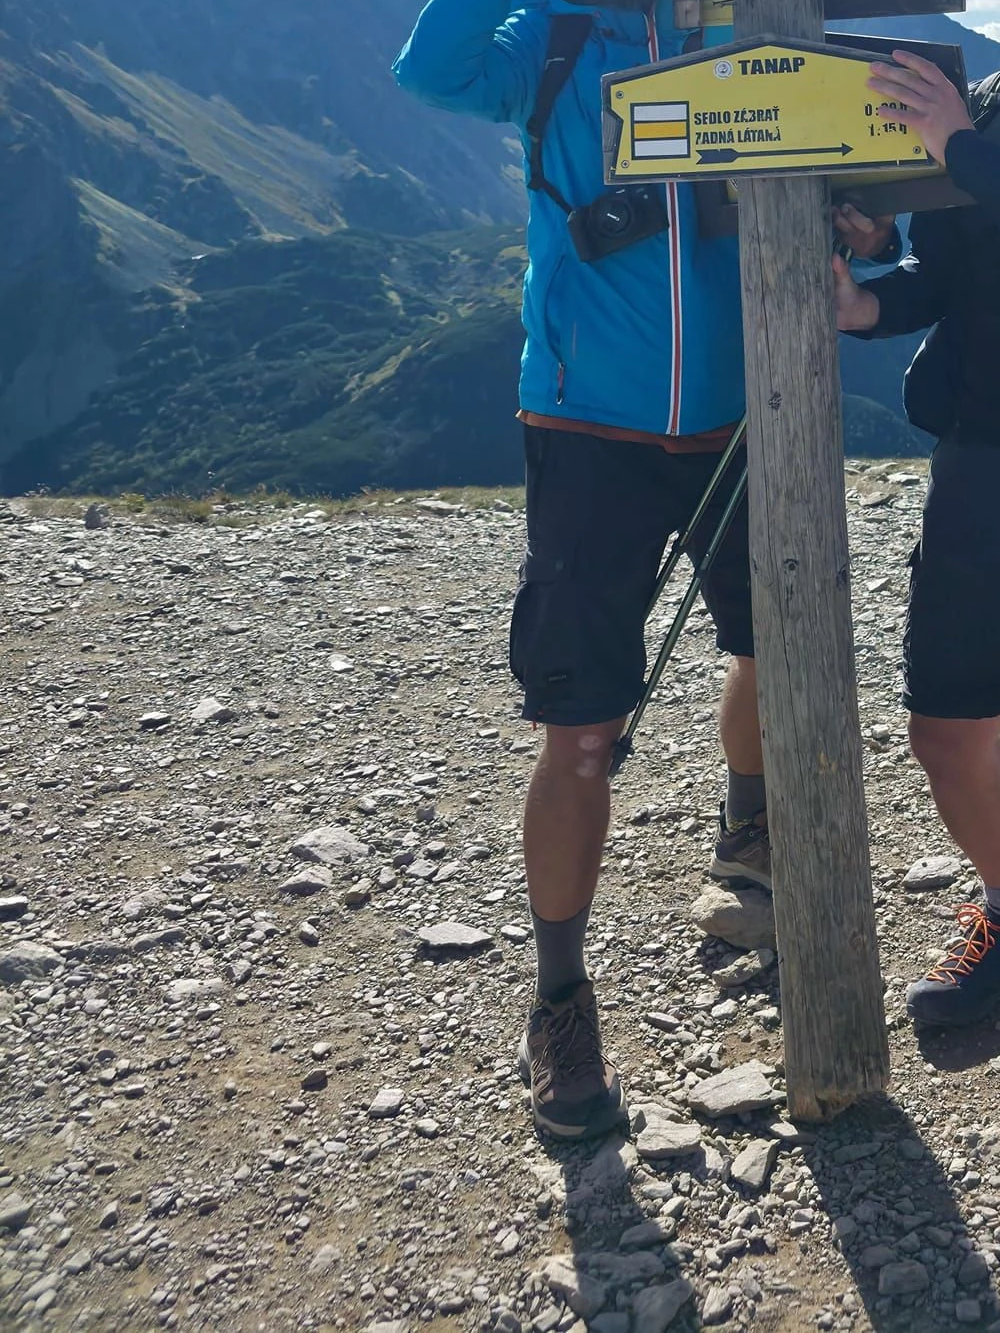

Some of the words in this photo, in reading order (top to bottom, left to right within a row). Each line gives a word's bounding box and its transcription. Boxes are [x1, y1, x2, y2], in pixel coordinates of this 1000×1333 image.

[738, 56, 806, 76] TANAP
[694, 110, 731, 126] SEDLO
[695, 128, 735, 145] ZADNÁ
